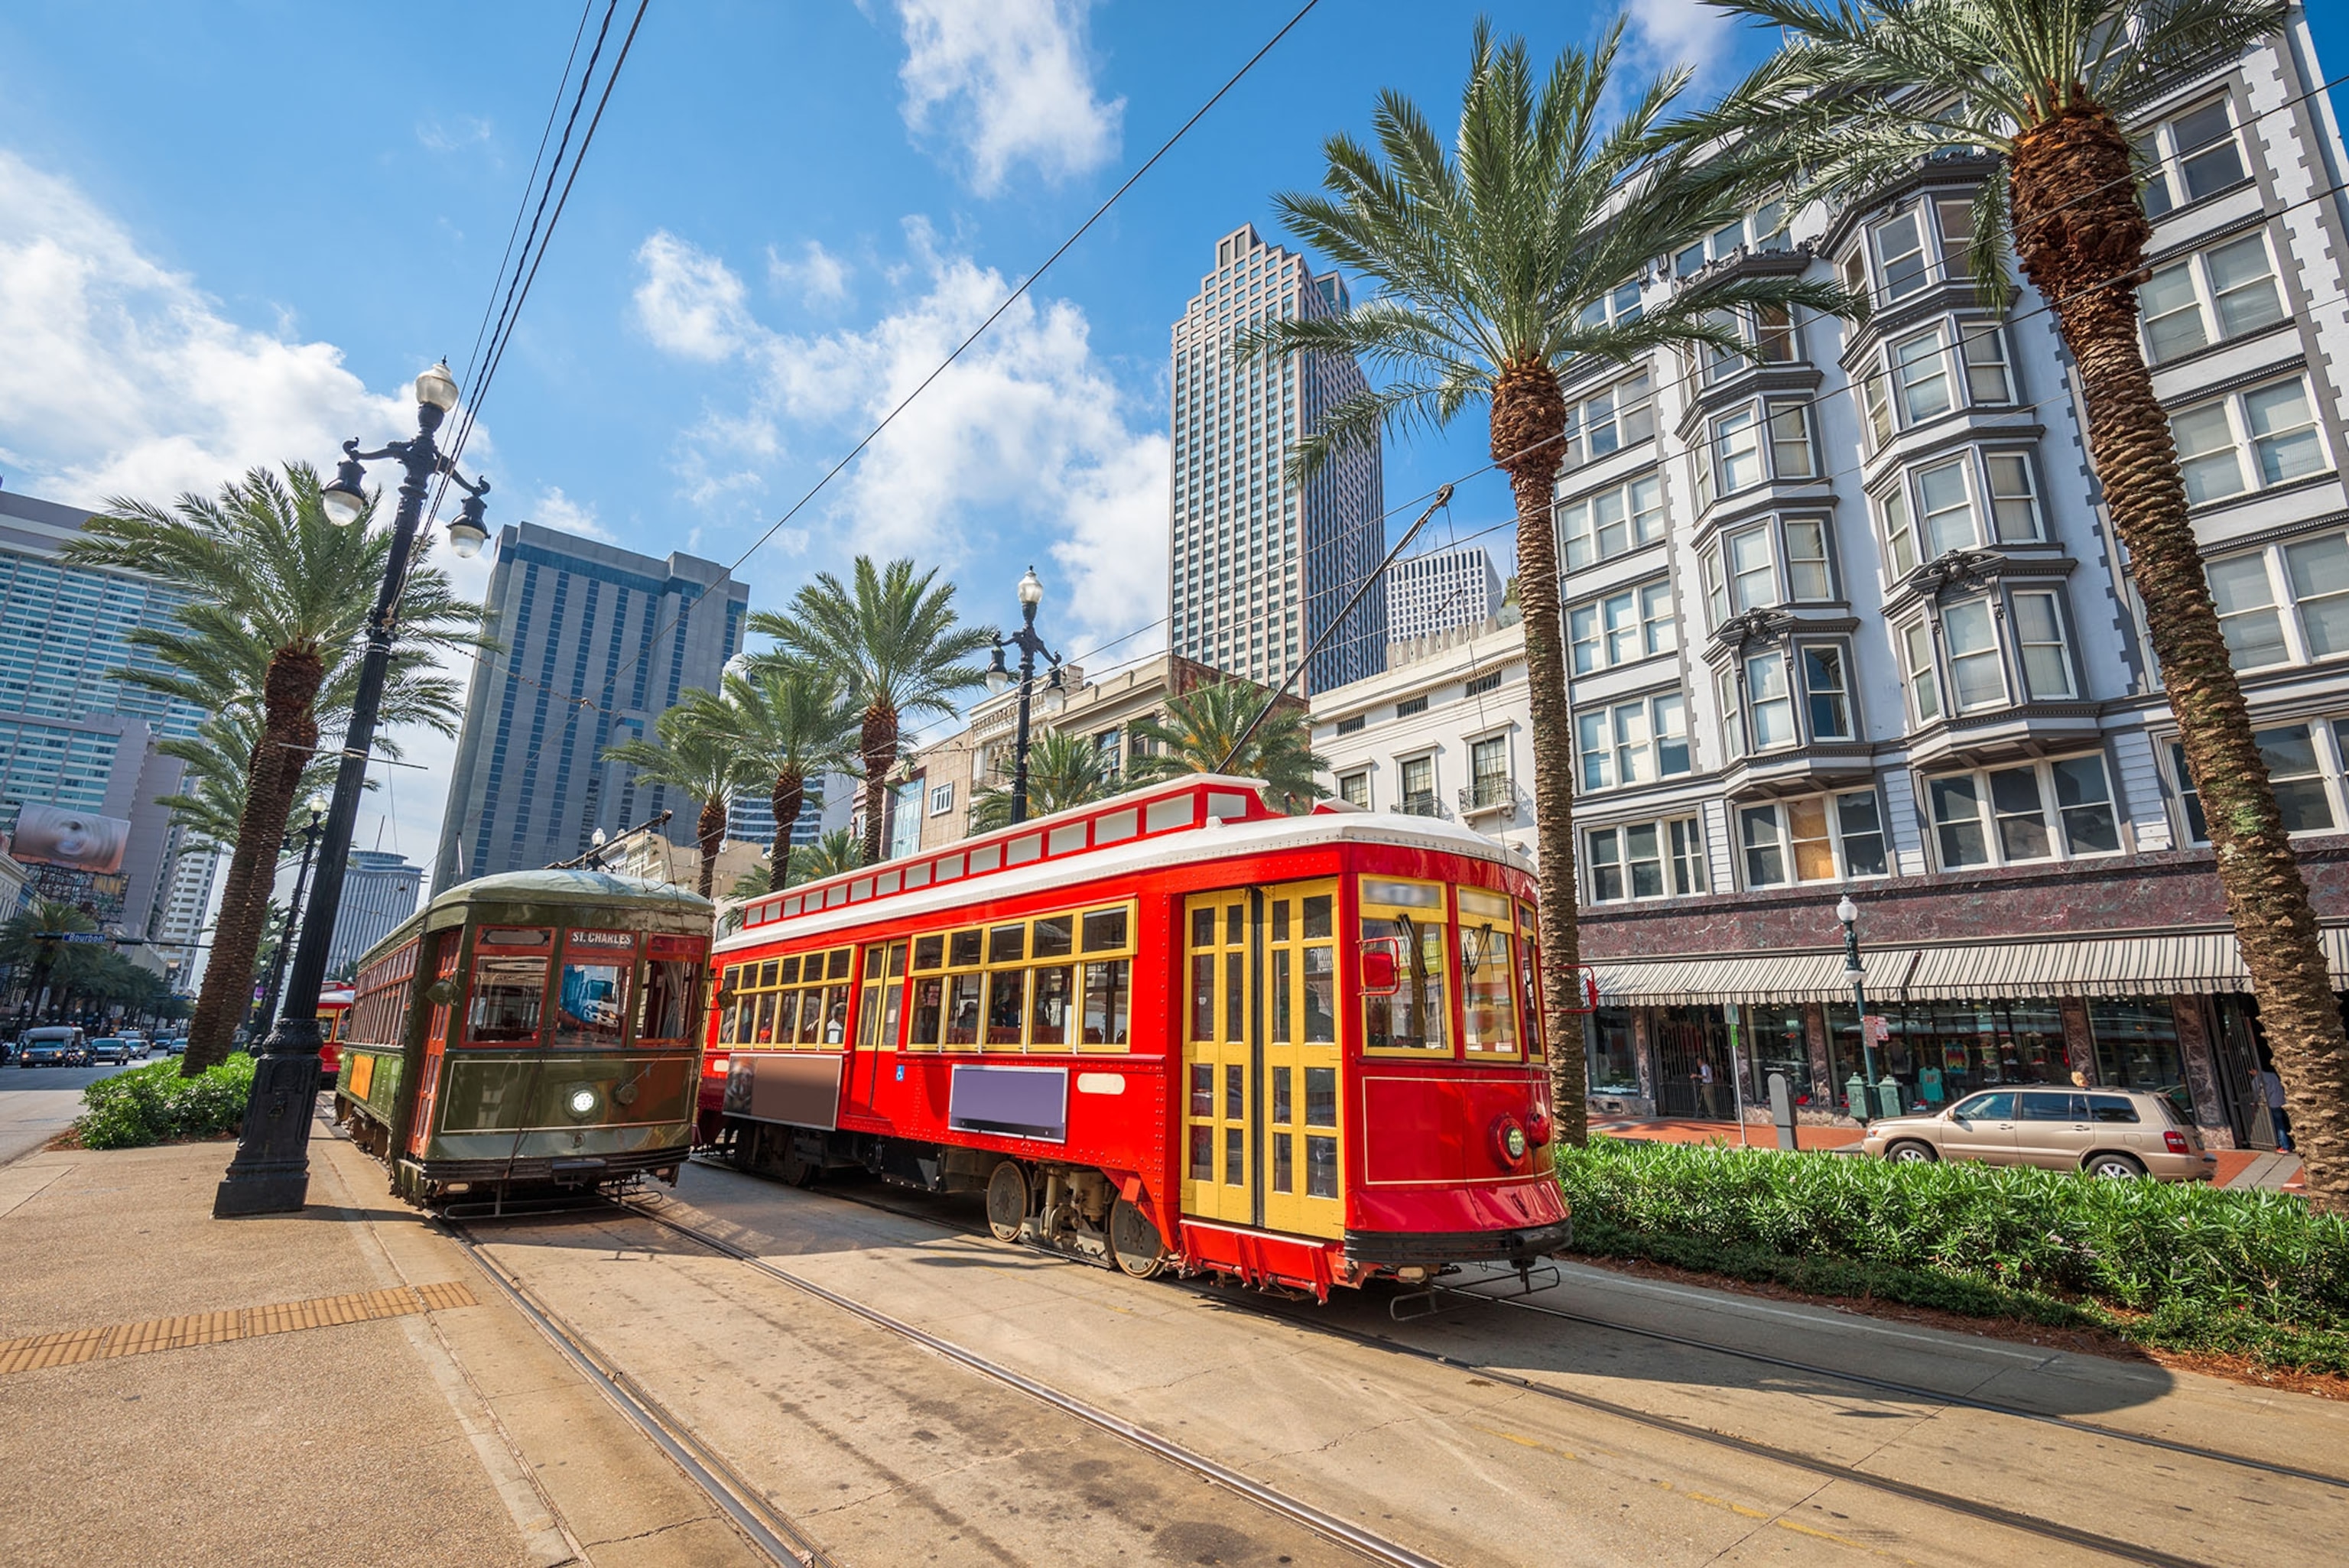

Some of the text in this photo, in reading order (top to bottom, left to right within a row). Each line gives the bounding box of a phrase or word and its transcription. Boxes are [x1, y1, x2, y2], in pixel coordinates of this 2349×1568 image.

[69, 932, 104, 943] Bourbon
[572, 932, 632, 945] ST. CHARLES
